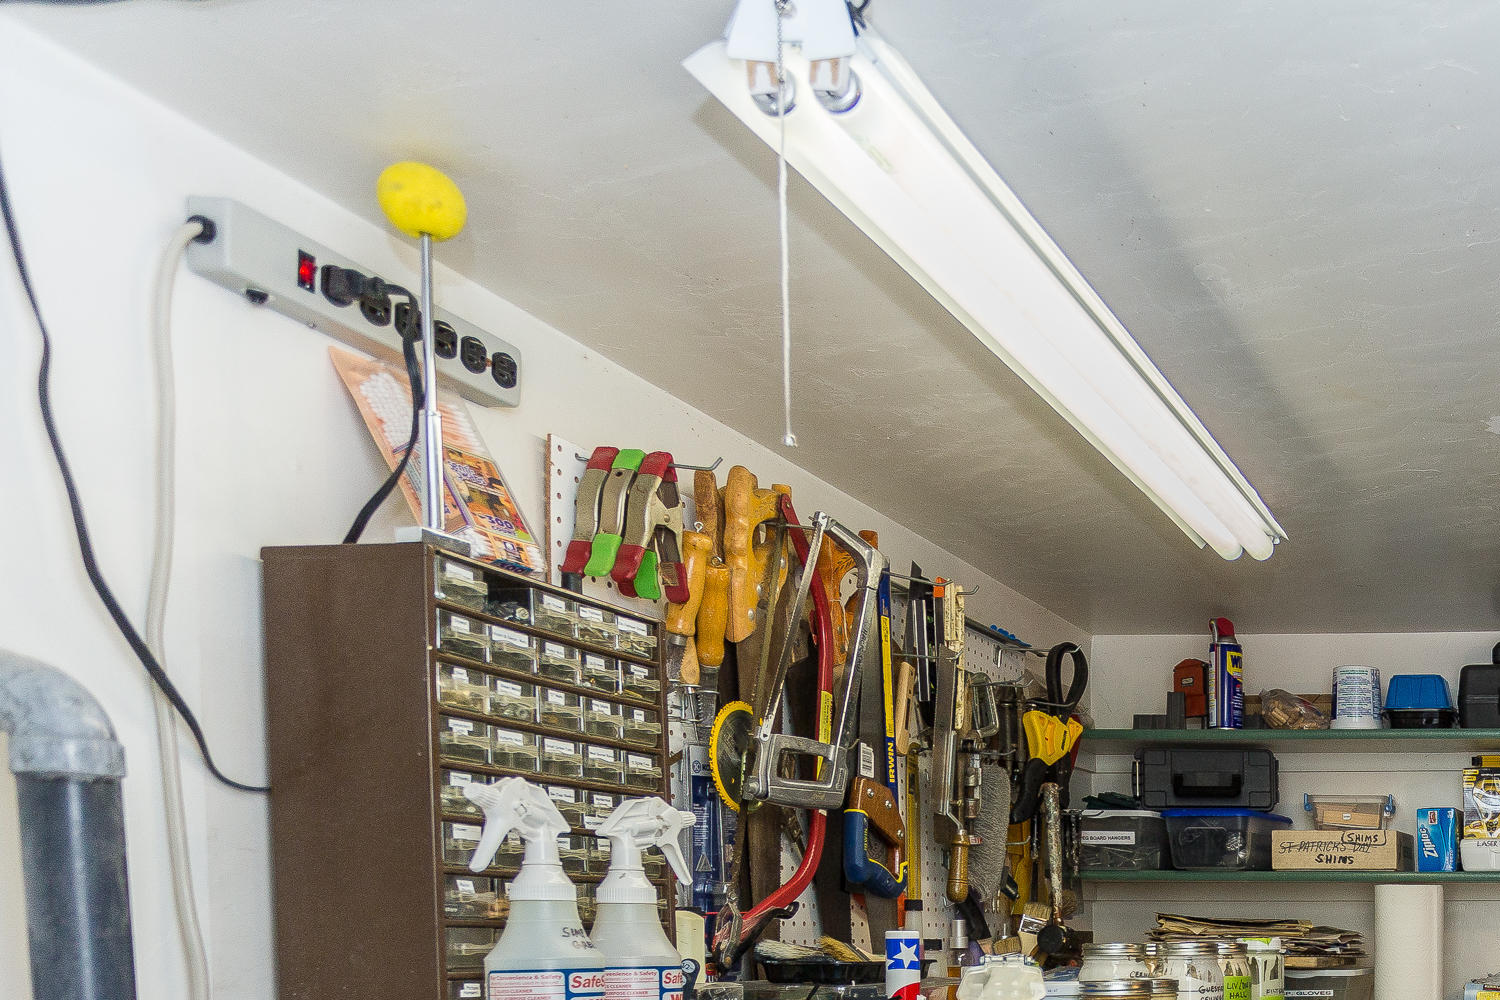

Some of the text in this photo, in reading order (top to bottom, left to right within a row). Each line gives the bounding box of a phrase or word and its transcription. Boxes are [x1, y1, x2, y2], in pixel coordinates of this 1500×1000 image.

[1347, 832, 1378, 842] SHIMS
[1419, 826, 1439, 858] Ziploc
[1314, 854, 1354, 864] SHIMS
[1230, 992, 1248, 1000] HALL
